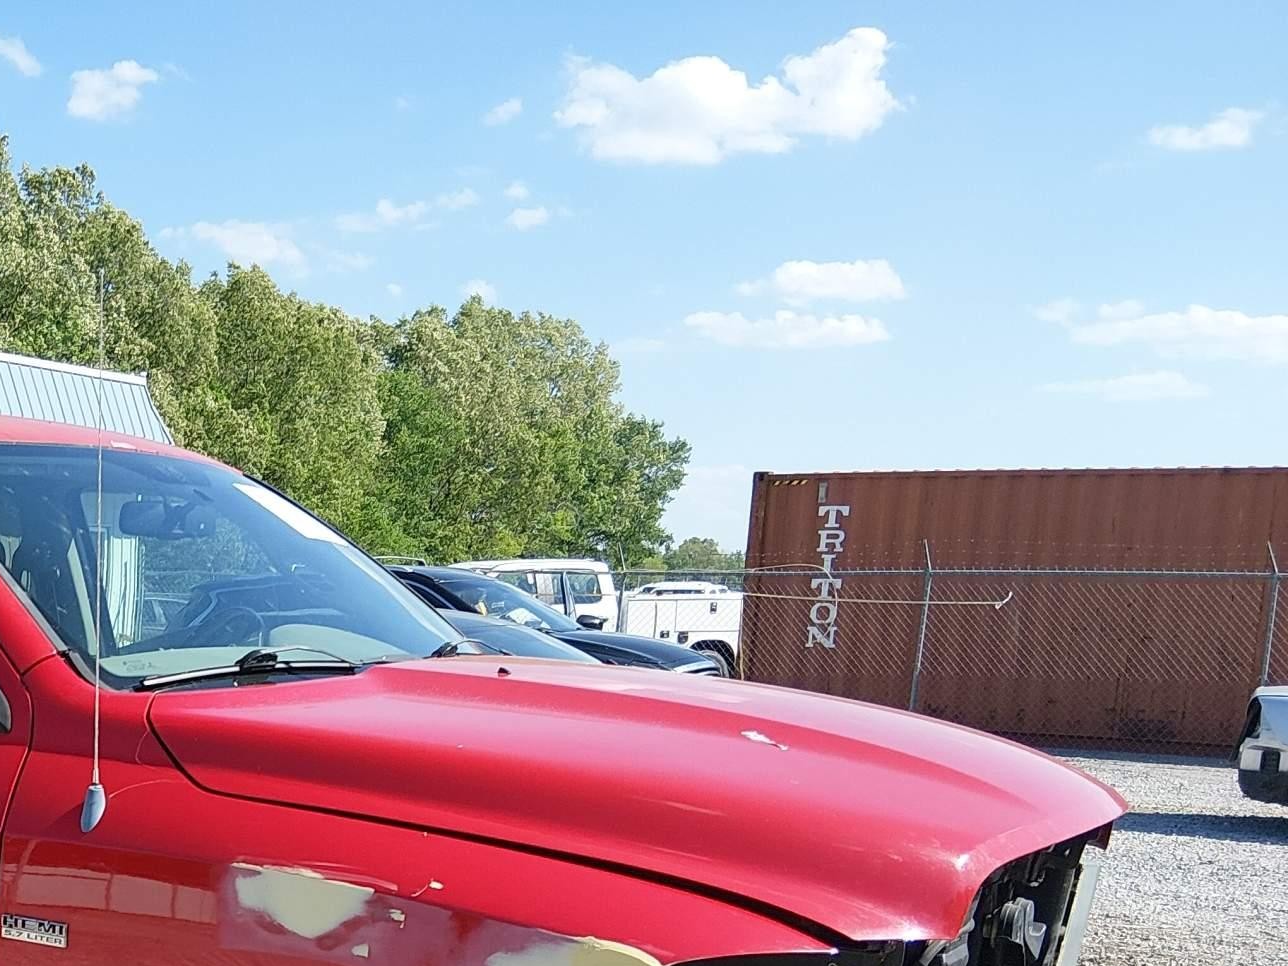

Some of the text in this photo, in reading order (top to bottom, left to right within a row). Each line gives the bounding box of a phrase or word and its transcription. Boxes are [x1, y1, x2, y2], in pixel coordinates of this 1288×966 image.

[805, 505, 850, 648] TRITON
[2, 915, 65, 936] HEMI
[4, 929, 63, 945] 5.7 LITER
